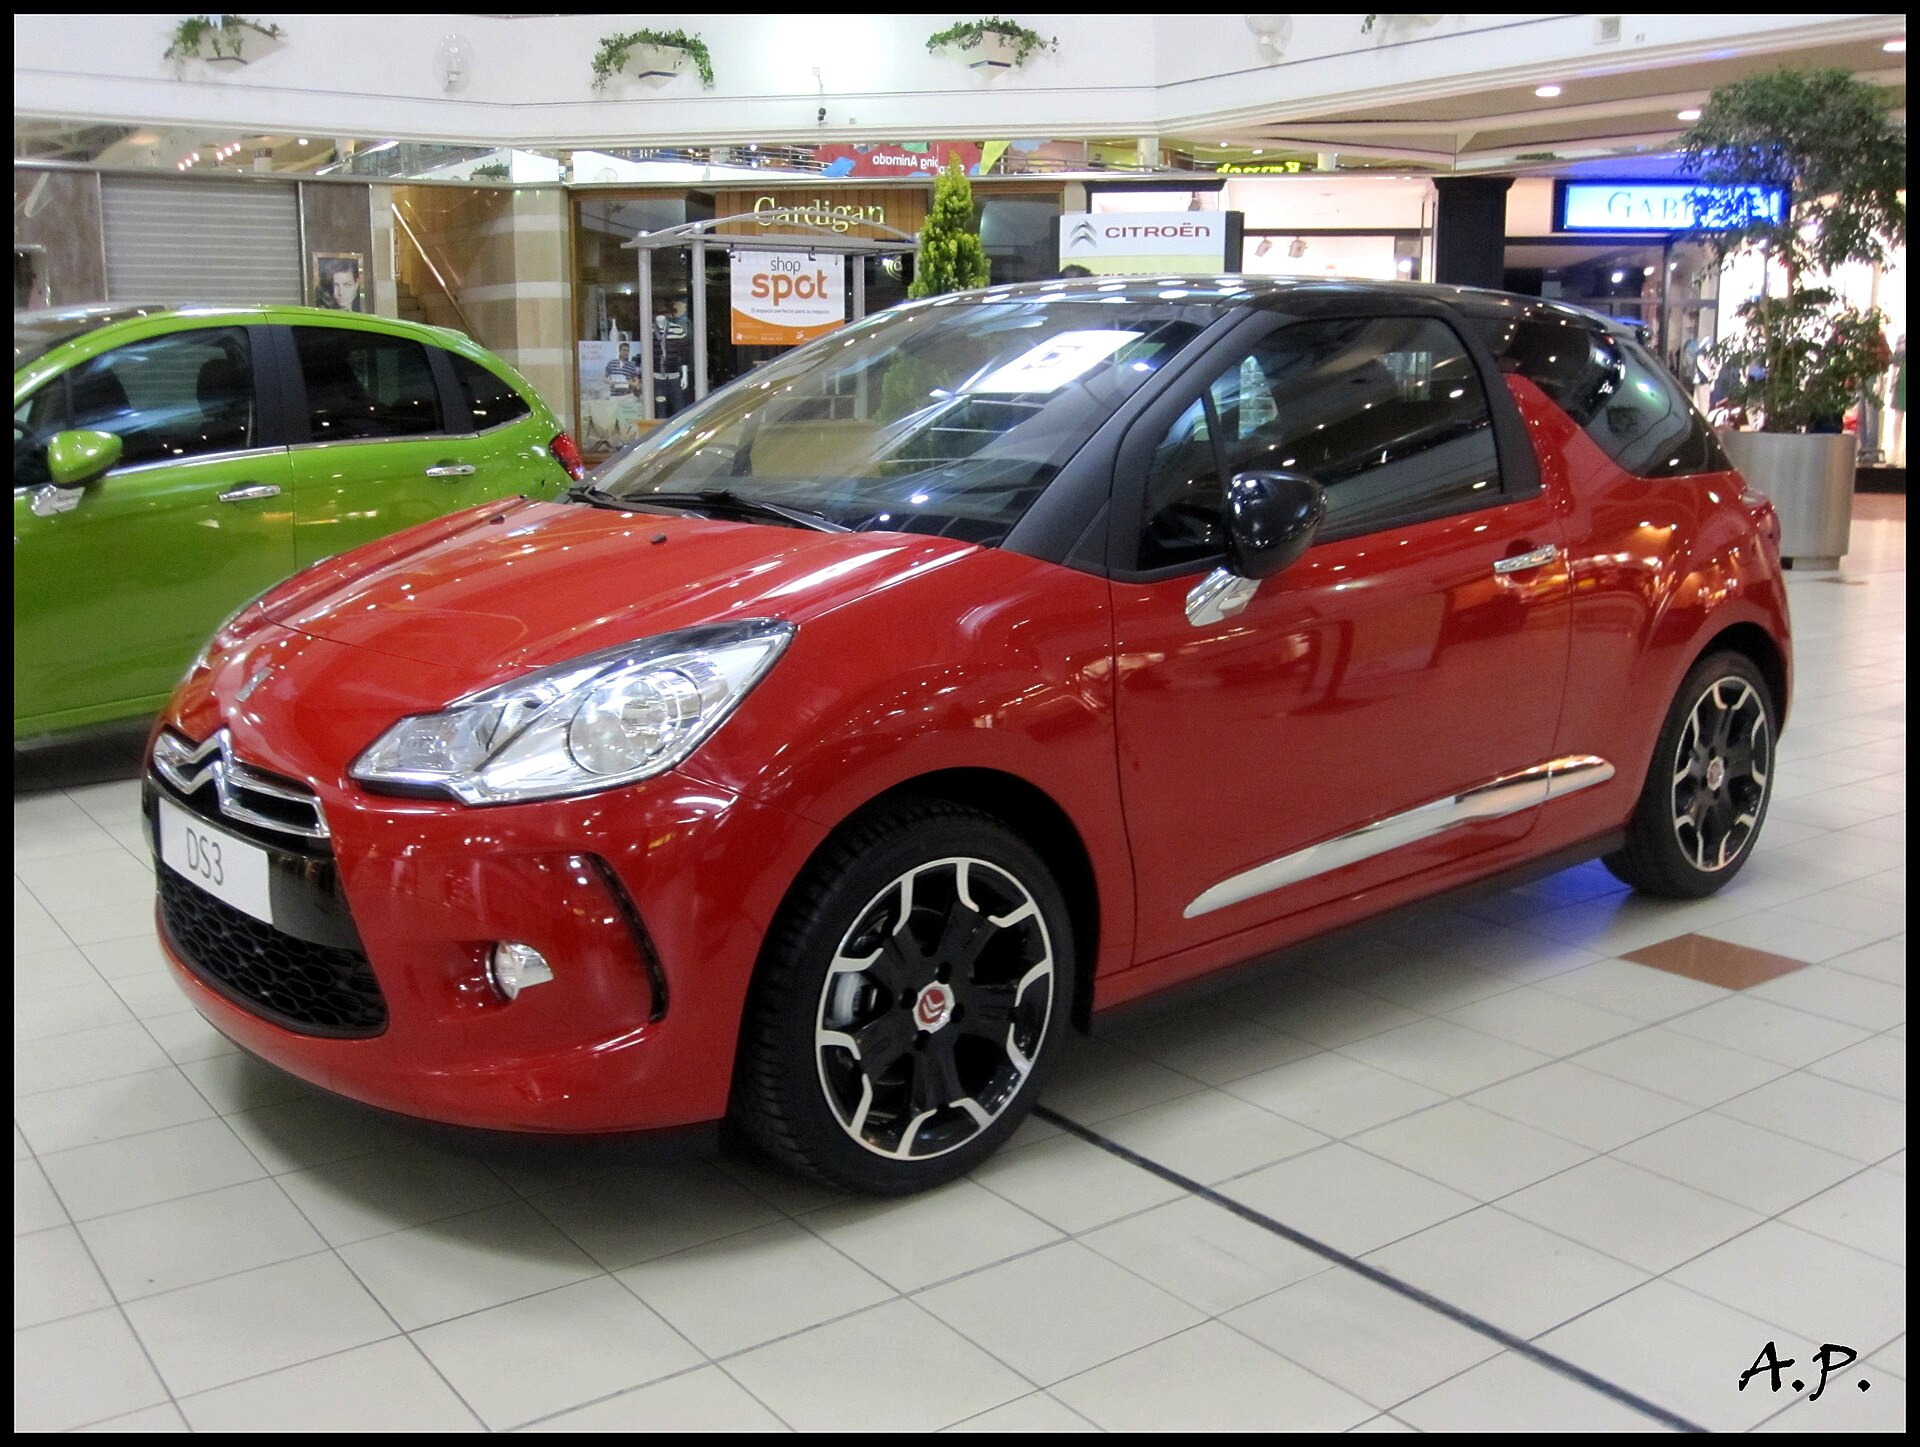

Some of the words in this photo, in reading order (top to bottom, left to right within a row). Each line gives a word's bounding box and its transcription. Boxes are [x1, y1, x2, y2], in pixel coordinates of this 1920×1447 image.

[753, 196, 886, 233] Cardigan
[770, 256, 801, 275] shop
[751, 269, 828, 307] spot
[186, 828, 224, 886] DS3
